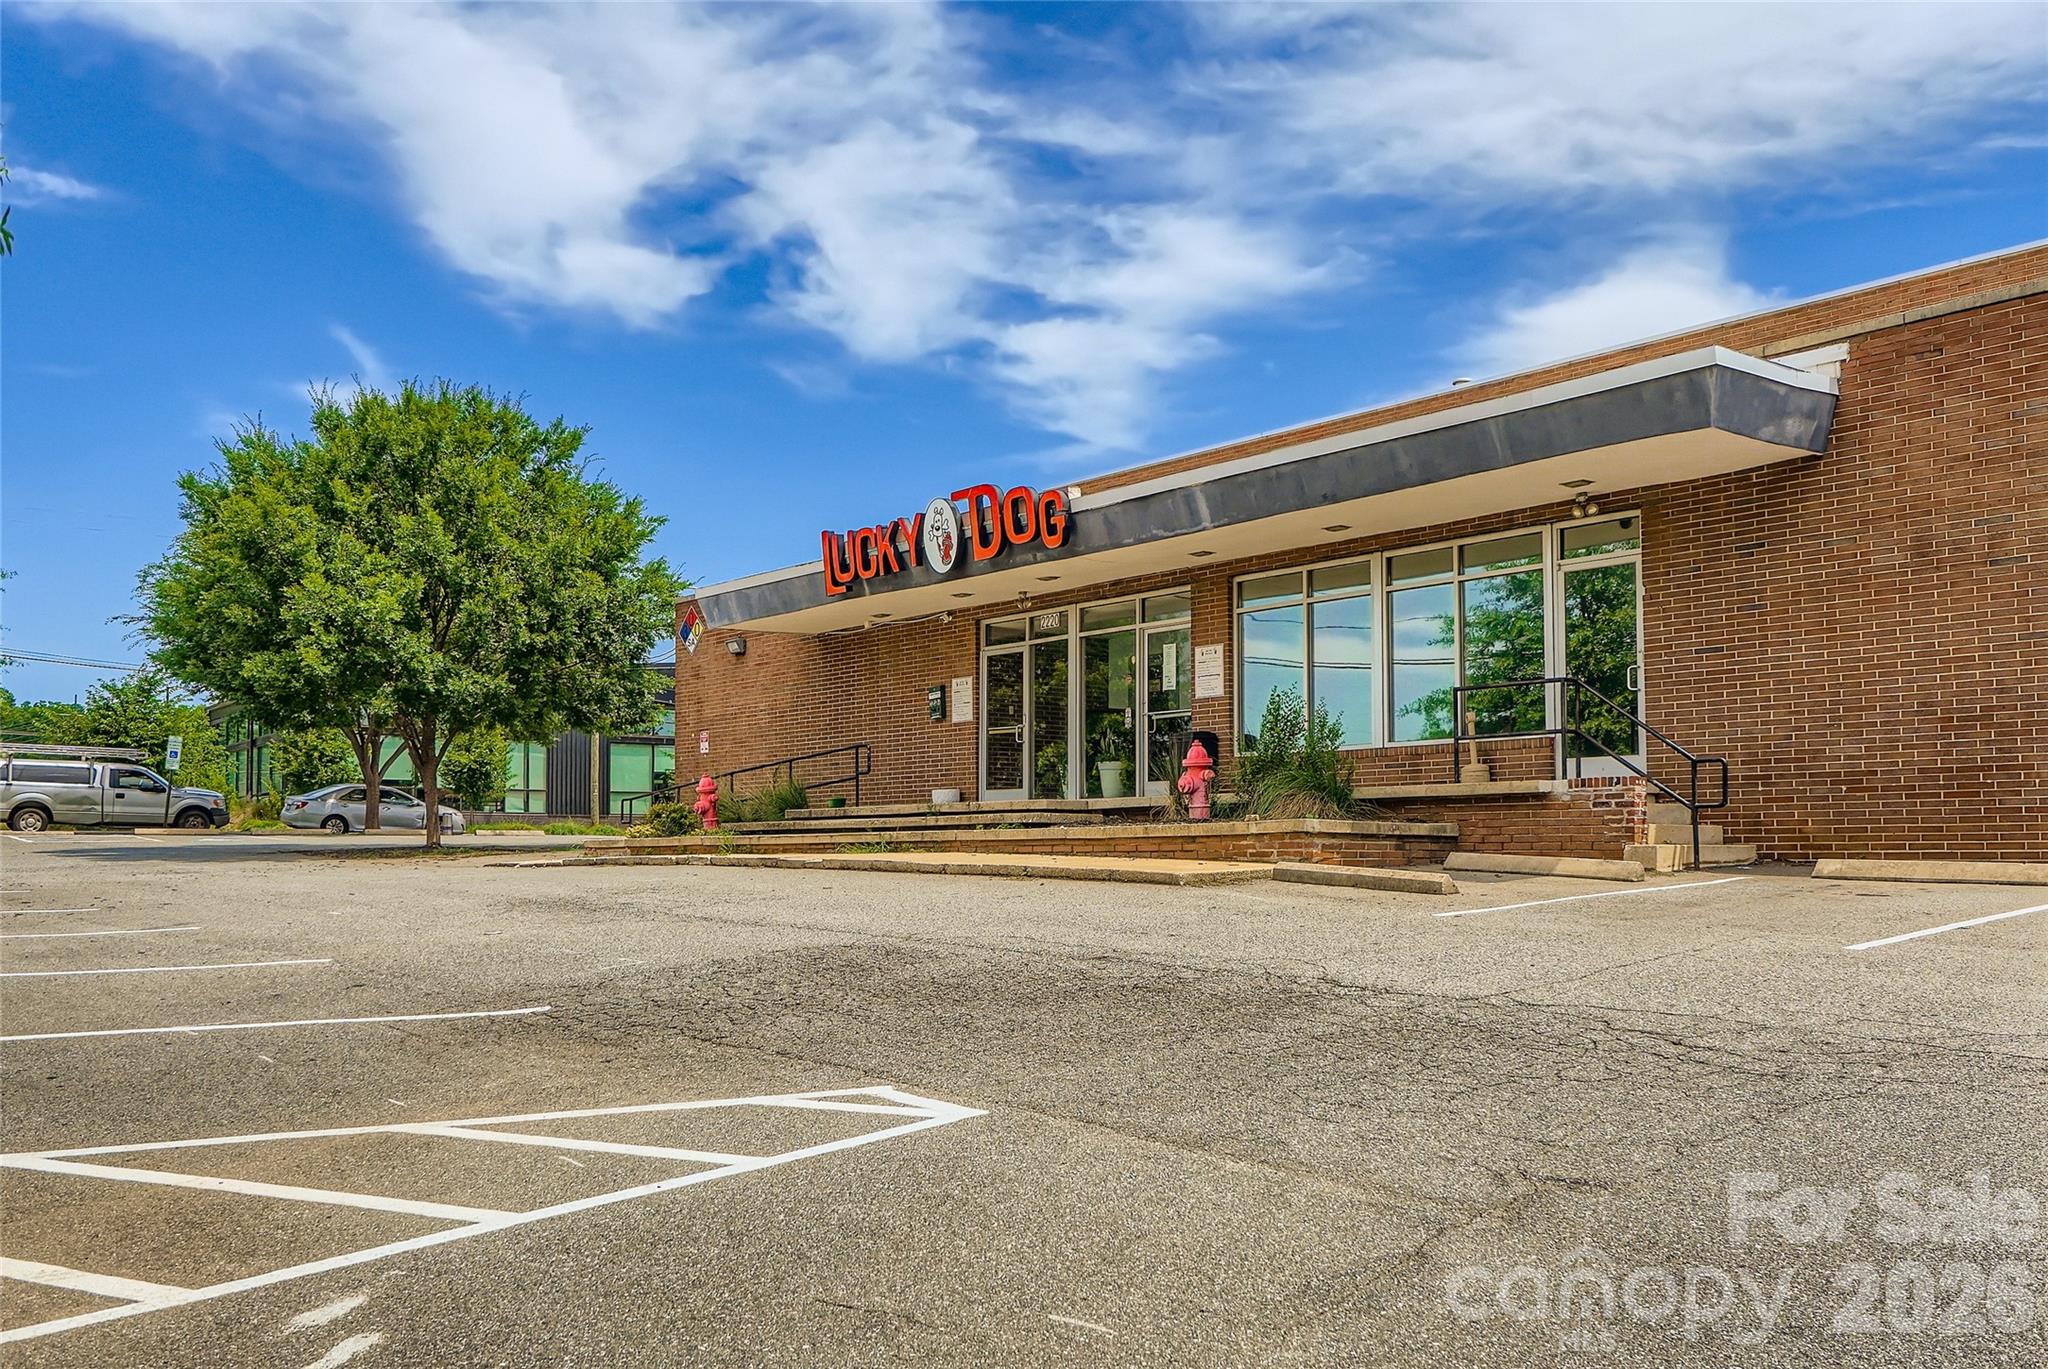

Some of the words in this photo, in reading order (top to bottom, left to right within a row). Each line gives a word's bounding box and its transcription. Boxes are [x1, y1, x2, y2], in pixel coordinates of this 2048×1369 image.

[821, 513, 924, 597] LUCKY
[951, 484, 1070, 561] DOG
[1041, 613, 1059, 629] 2220
